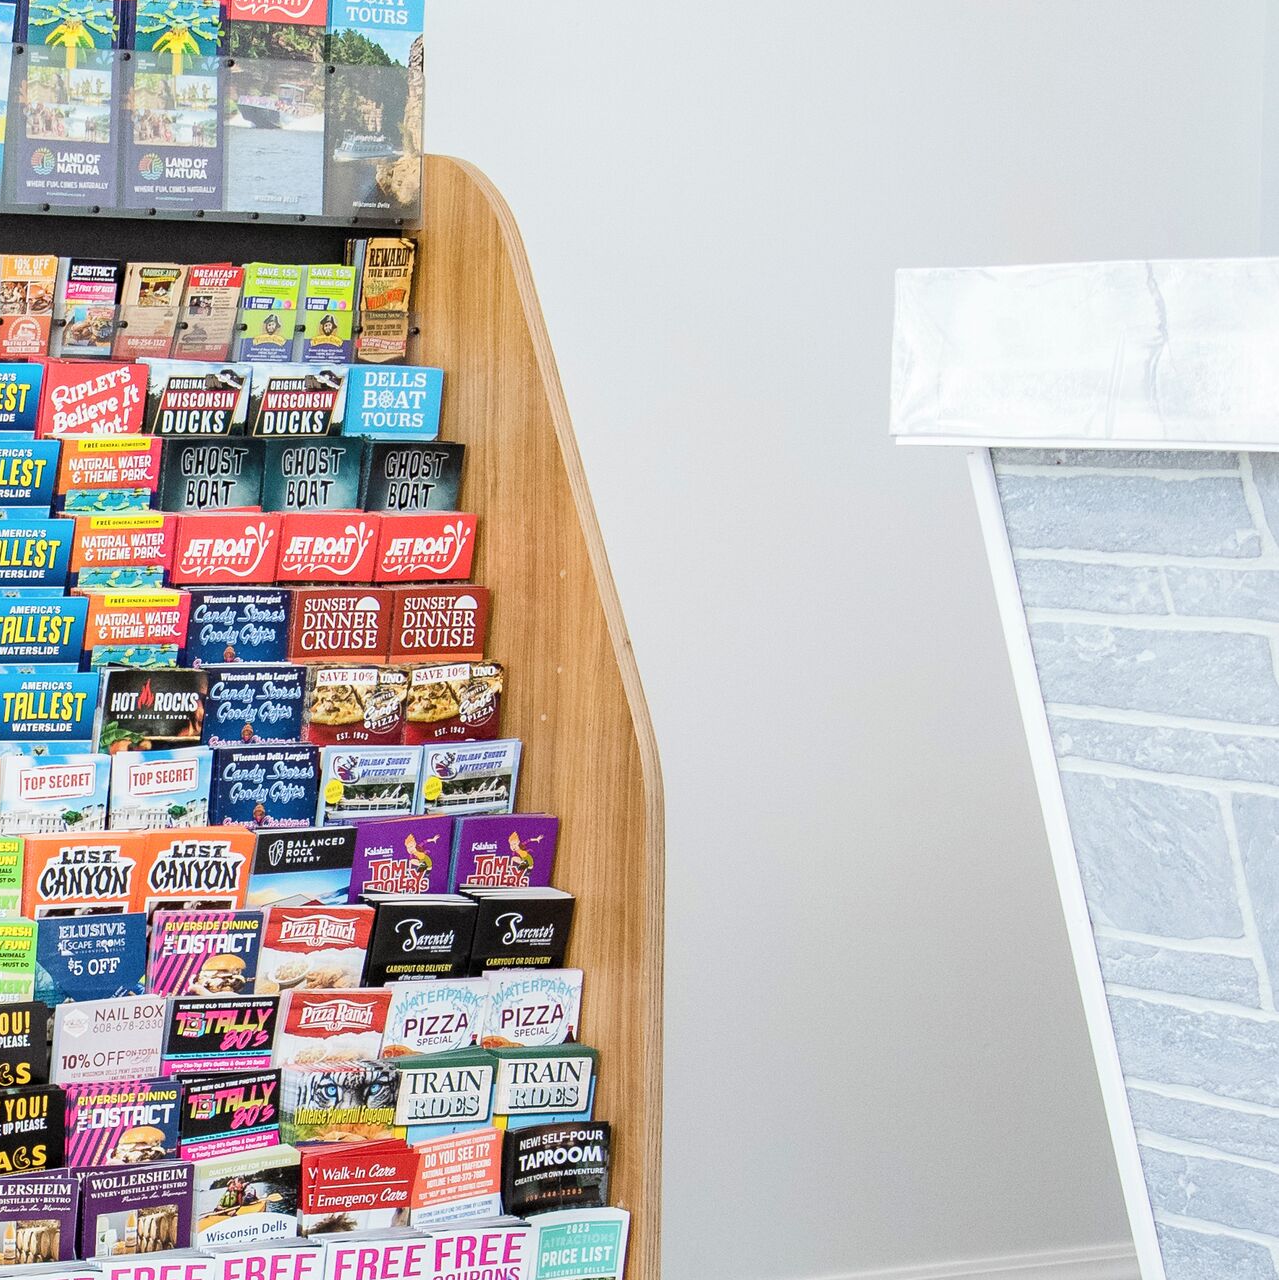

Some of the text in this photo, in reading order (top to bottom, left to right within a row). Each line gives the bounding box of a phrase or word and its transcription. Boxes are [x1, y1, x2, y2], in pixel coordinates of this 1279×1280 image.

[346, 6, 408, 25] TOURS
[57, 151, 101, 165] LAND OF
[57, 162, 100, 176] NATURA
[369, 248, 409, 267] REWARD!
[78, 265, 117, 278] DISTRICT
[193, 269, 238, 278] BREAKFAST
[199, 277, 228, 287] BUFFET
[51, 365, 133, 409] RIPLEY'S
[53, 384, 140, 434] Believe It
[94, 410, 132, 434] Not!
[181, 446, 248, 478] GHOST
[186, 479, 238, 510] BOAT
[184, 538, 257, 558] JET BOAT
[181, 557, 249, 566] ADVENTURES
[404, 598, 455, 610] SUNSET
[402, 611, 476, 630] DINNER
[400, 630, 475, 648] CRUISE
[415, 665, 468, 681] SAVE 10%
[111, 691, 199, 712] HOT ROCKS
[457, 760, 502, 771] WATERSPORTS
[24, 773, 91, 790] TOP SECRET
[287, 836, 346, 849] BALANCED
[471, 841, 498, 852] Kalahari
[62, 849, 117, 864] LOST
[39, 863, 135, 896] CANYON
[165, 920, 259, 932] RIVERSIDE DINING
[177, 933, 256, 956] DISTRICT
[68, 957, 120, 976] $5 OFF
[95, 1003, 164, 1022] NAIL BOX
[501, 1004, 564, 1029] PIZZA
[92, 1018, 164, 1034] 608-678-2330
[514, 1026, 550, 1038] SPECIAL
[508, 1061, 584, 1084] TRAIN
[508, 1086, 579, 1109] RIDES
[519, 1145, 601, 1171] TAPROOM
[91, 1168, 188, 1191] WOLLERSHEIM
[322, 1163, 396, 1181] Walk-In Care
[317, 1190, 379, 1207] Emergency
[380, 1187, 408, 1202] Care
[206, 1221, 288, 1244] Wisconsin Dells
